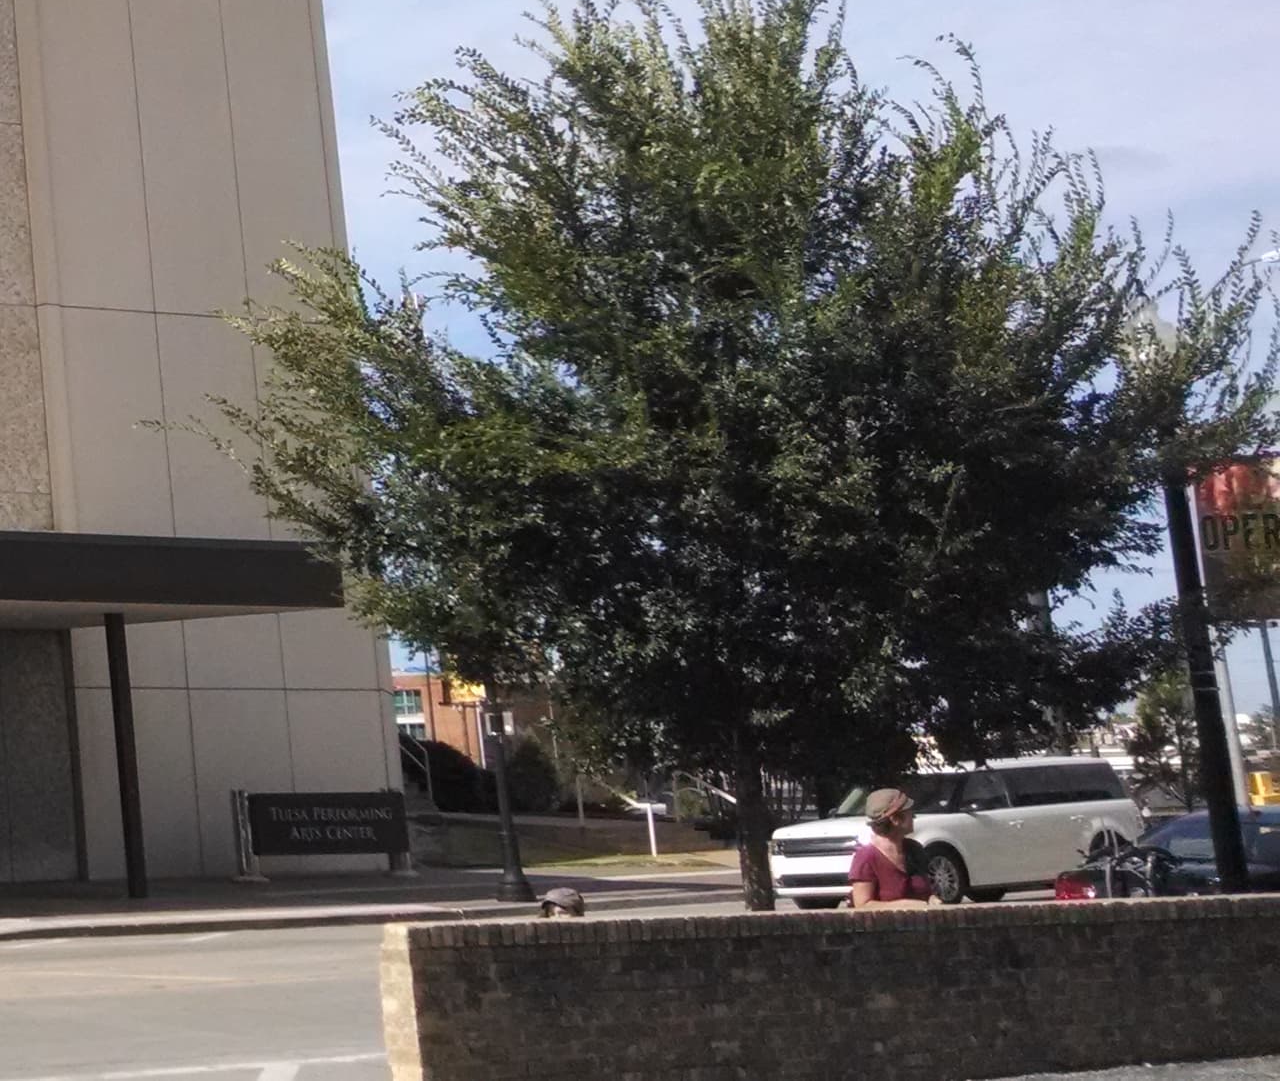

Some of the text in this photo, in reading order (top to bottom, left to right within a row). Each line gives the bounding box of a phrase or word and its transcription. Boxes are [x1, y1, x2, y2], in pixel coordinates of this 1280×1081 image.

[270, 806, 393, 822] TULSA PERFORMING
[289, 825, 378, 841] ARTS CENTER
